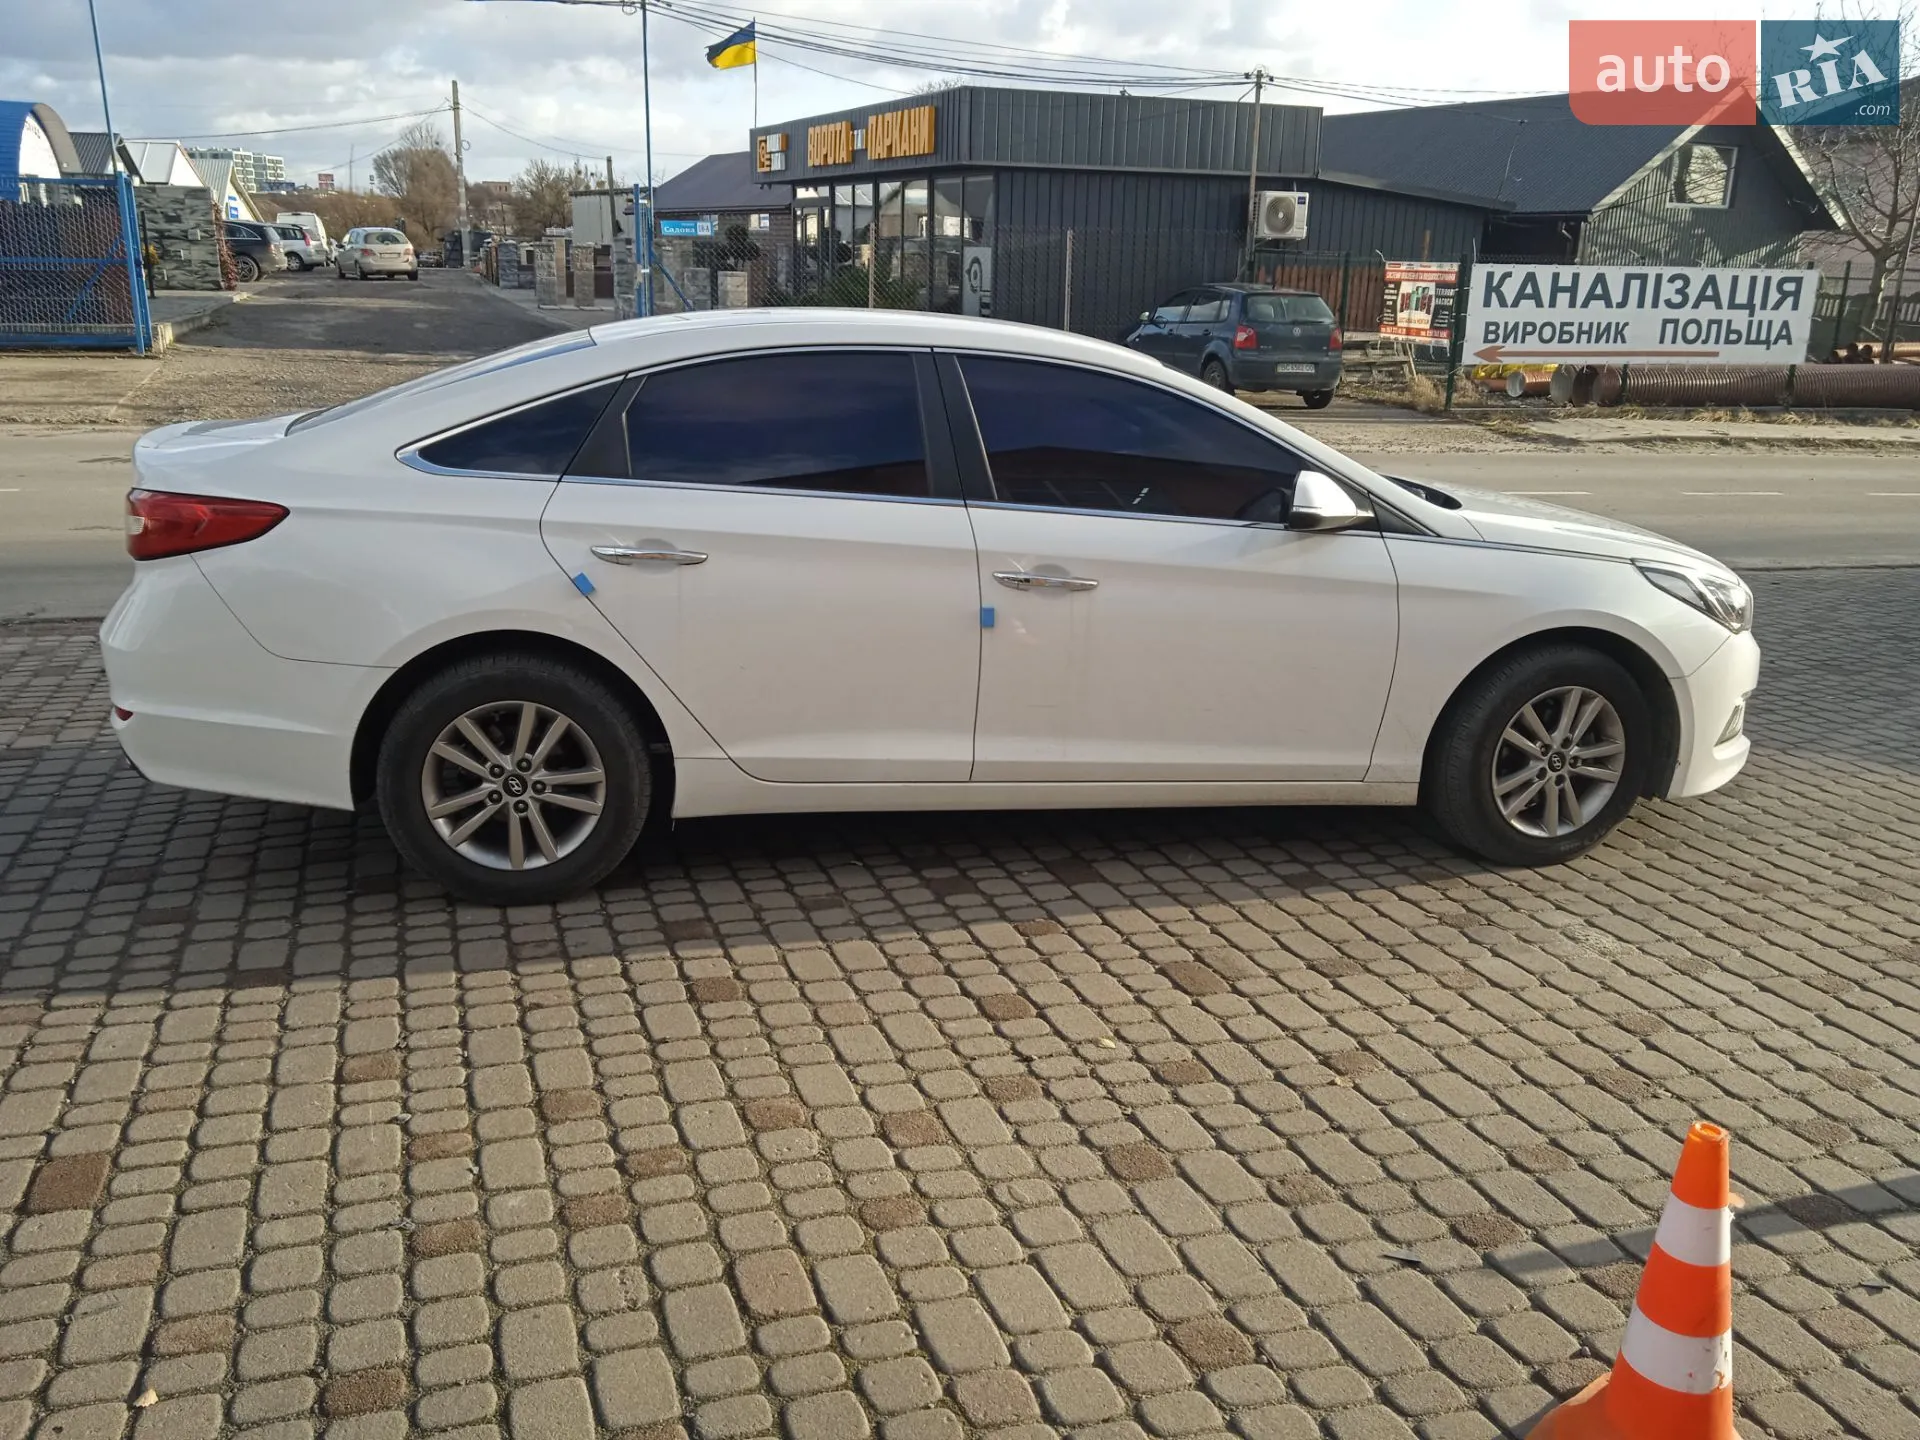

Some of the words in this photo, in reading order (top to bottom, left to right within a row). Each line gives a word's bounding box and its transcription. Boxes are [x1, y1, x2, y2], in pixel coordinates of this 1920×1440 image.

[808, 121, 851, 167] ВОРОТА
[867, 106, 932, 160] ПАРКАНИ
[1482, 270, 1804, 318] КАНАЛІЗАЦІЯ
[1482, 320, 1629, 345] ВИРОБНИК
[1659, 318, 1793, 351] ПОЛЬЩА
